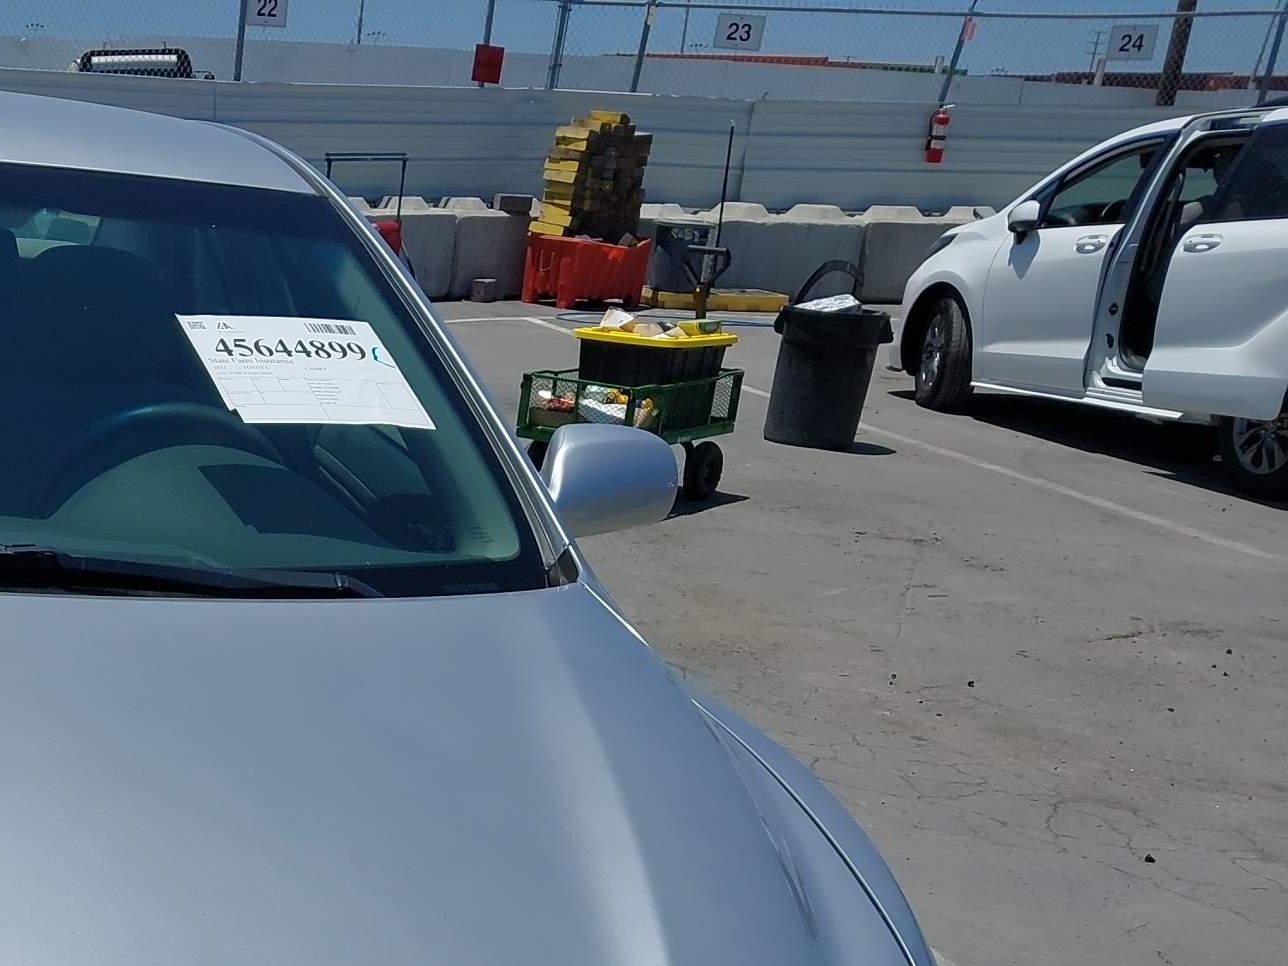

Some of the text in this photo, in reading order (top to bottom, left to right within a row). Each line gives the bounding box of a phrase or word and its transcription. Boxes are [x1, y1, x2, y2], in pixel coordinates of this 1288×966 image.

[257, 0, 278, 17] 22
[726, 22, 752, 42] 23
[1118, 33, 1144, 52] 24
[215, 338, 366, 361] 45644899
